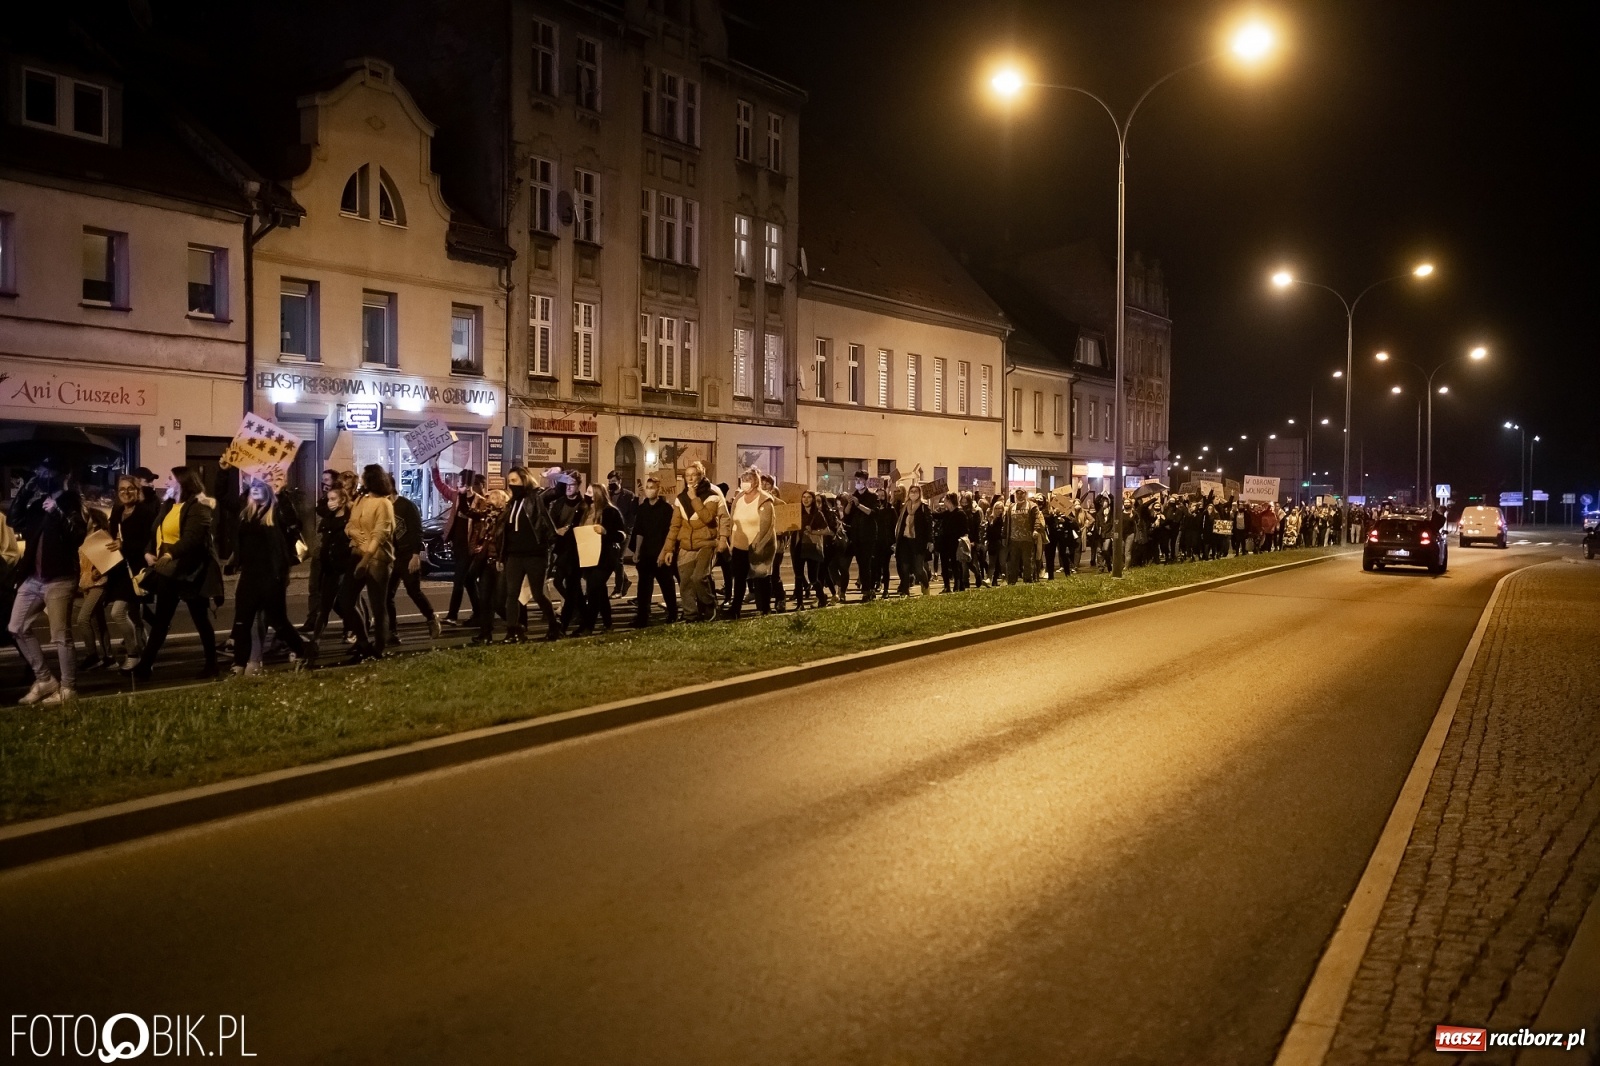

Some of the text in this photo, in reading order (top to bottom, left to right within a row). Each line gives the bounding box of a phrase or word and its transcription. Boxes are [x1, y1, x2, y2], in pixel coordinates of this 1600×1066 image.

[11, 380, 146, 407] Ani Ciuszek 3
[256, 372, 496, 405] EKSPRESOWA NAPRAWA OBUWIA
[405, 418, 439, 443] REAL MEN
[417, 430, 436, 449] ARE
[412, 430, 451, 460] FEMINISTS
[1246, 487, 1275, 496] WOLNOŚCI
[1252, 479, 1276, 487] OBRONIE
